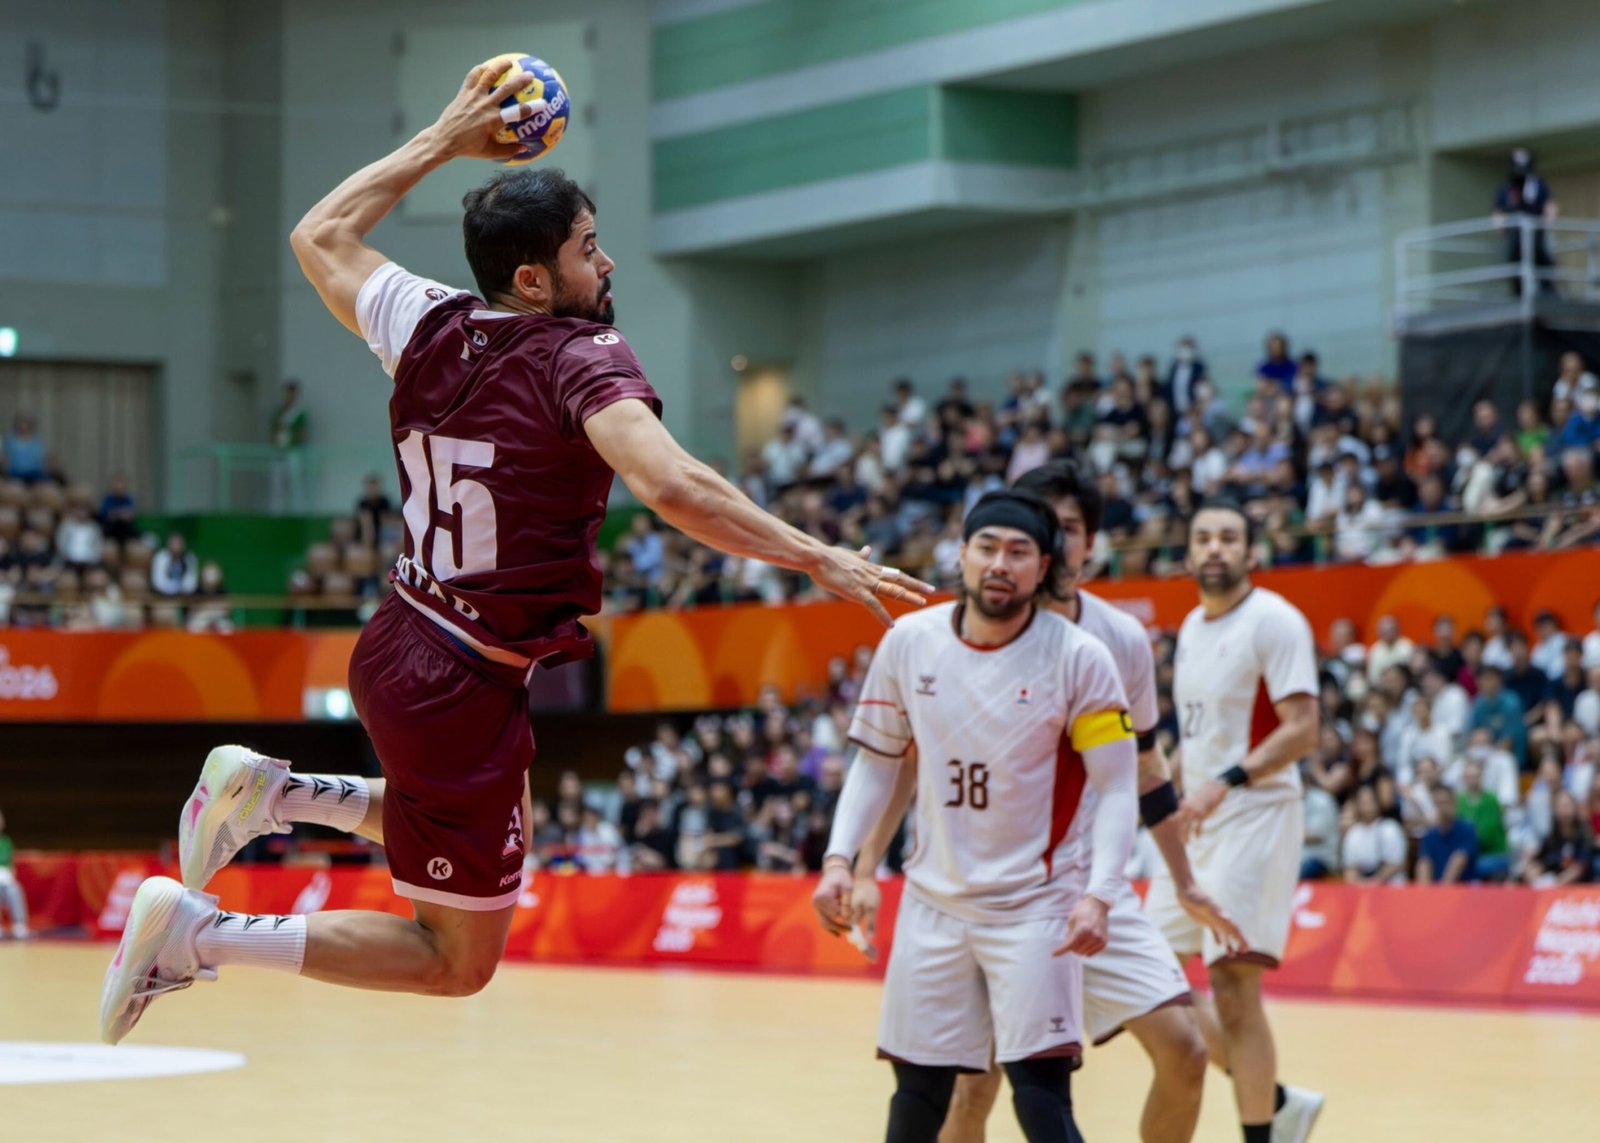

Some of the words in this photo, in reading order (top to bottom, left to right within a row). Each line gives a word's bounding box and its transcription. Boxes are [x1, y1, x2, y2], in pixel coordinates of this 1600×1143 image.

[517, 90, 566, 139] molten
[397, 430, 498, 581] 15
[945, 759, 990, 810] 38
